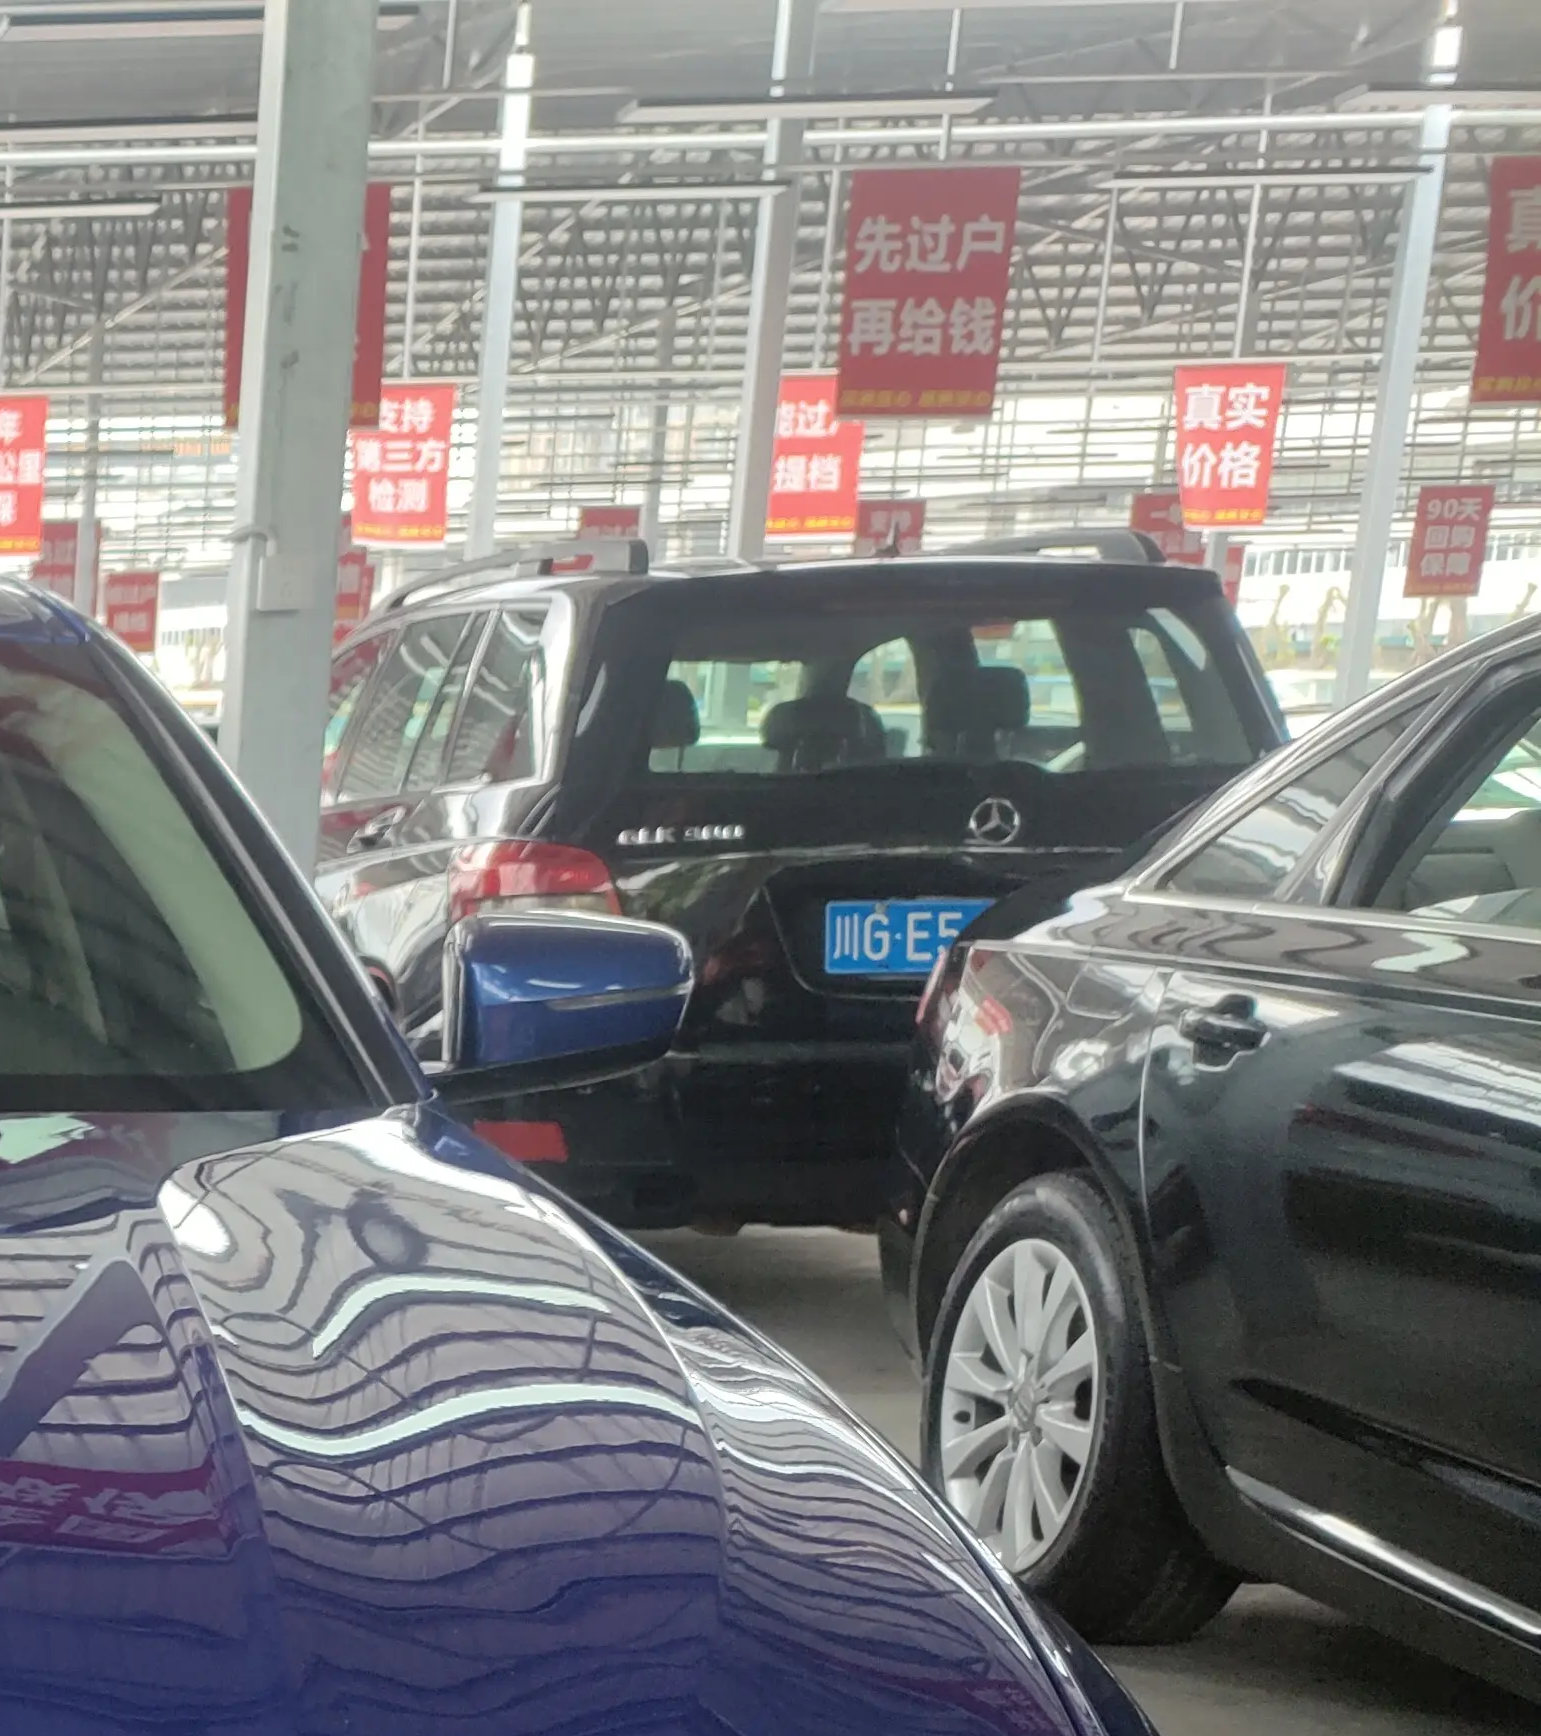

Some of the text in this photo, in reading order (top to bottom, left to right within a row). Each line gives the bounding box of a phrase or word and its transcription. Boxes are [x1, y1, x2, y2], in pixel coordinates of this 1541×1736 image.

[854, 214, 1007, 273] 先过户
[847, 297, 997, 356] 再给钱
[1183, 382, 1271, 430] 真实
[1181, 440, 1262, 488] 价格
[1426, 498, 1482, 521] 90天
